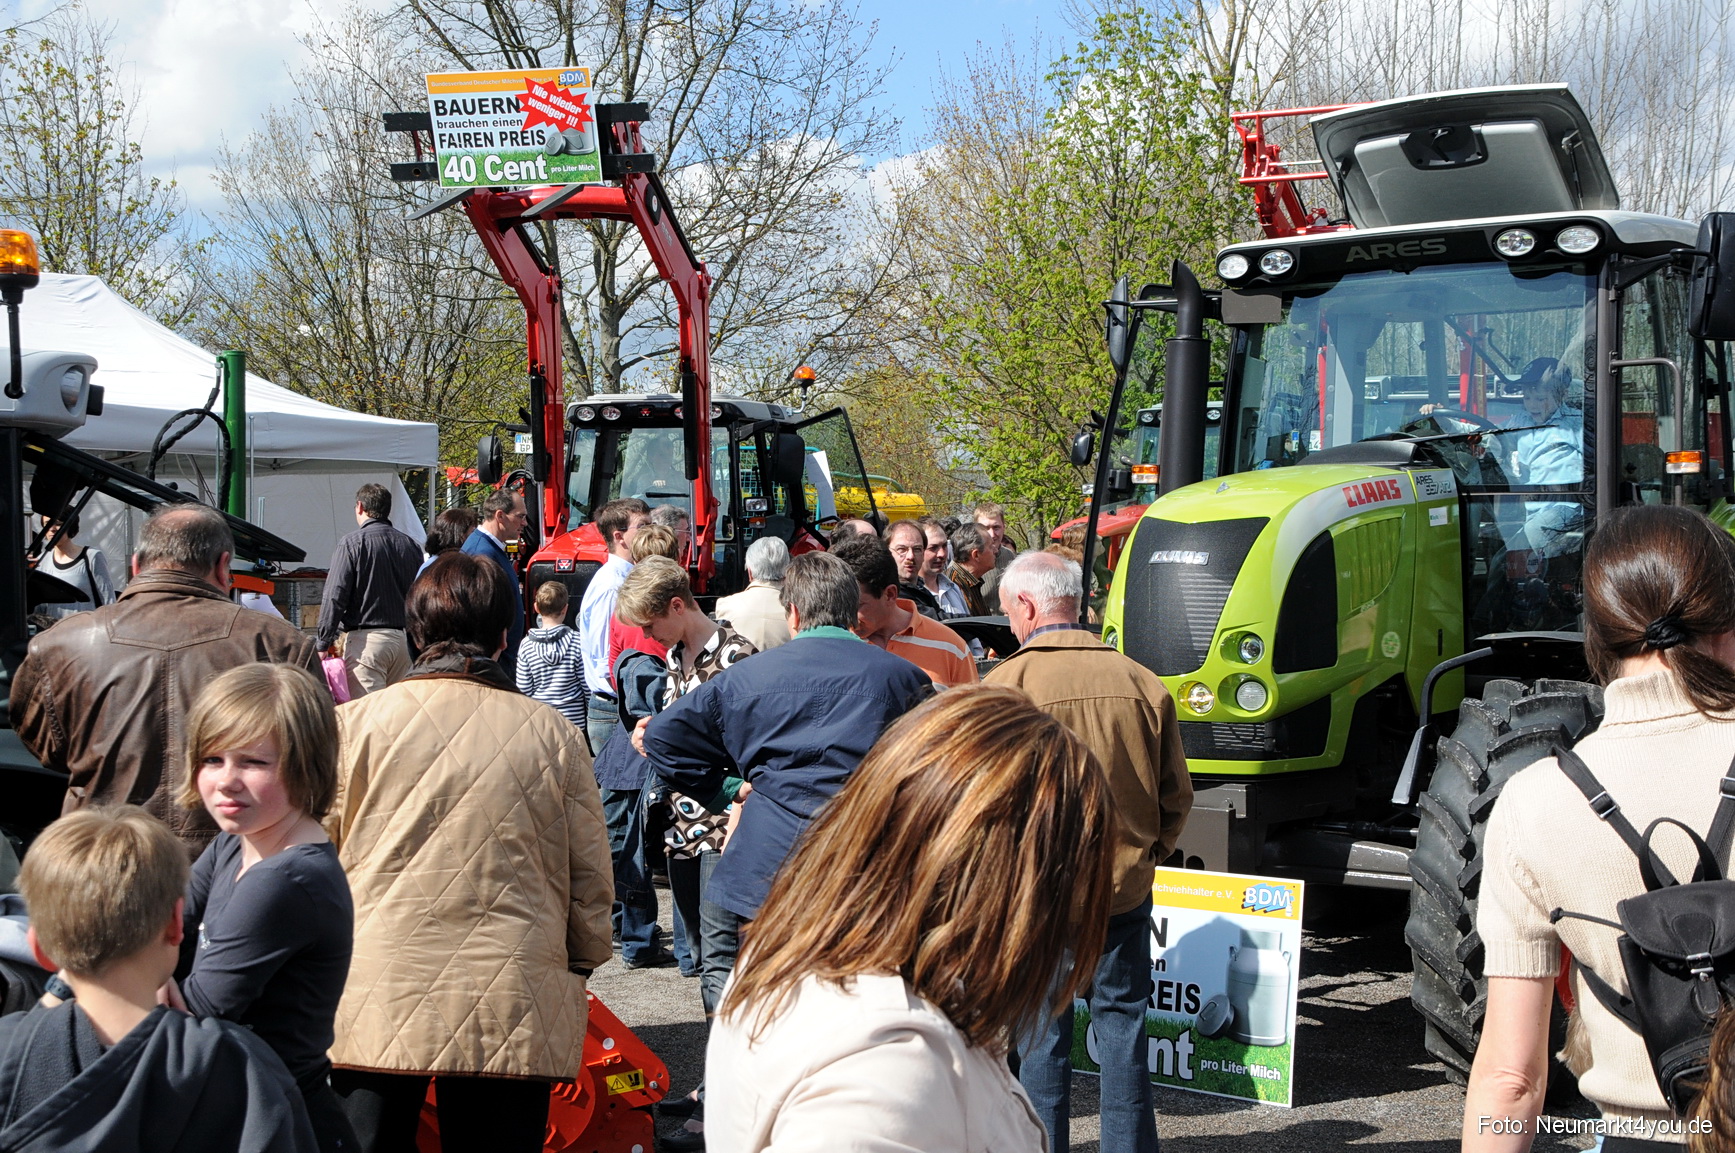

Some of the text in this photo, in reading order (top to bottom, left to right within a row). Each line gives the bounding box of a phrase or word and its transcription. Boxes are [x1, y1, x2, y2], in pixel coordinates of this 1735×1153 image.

[559, 72, 585, 83] BDM
[434, 97, 521, 116] BAUERN
[527, 97, 566, 120] weniger
[531, 84, 583, 115] Nie wieder
[437, 117, 524, 129] brauchen einen
[438, 129, 546, 149] FAIREN PREIS
[444, 153, 549, 183] 40 Cent
[550, 163, 596, 174] pro Liter Milch
[1346, 237, 1447, 262] ARES
[1416, 475, 1433, 485] ARES
[1342, 479, 1402, 508] CLAAS
[1216, 890, 1236, 899] e.V.
[1245, 887, 1290, 907] BDM
[1200, 1059, 1281, 1081] pro Liter Milch
